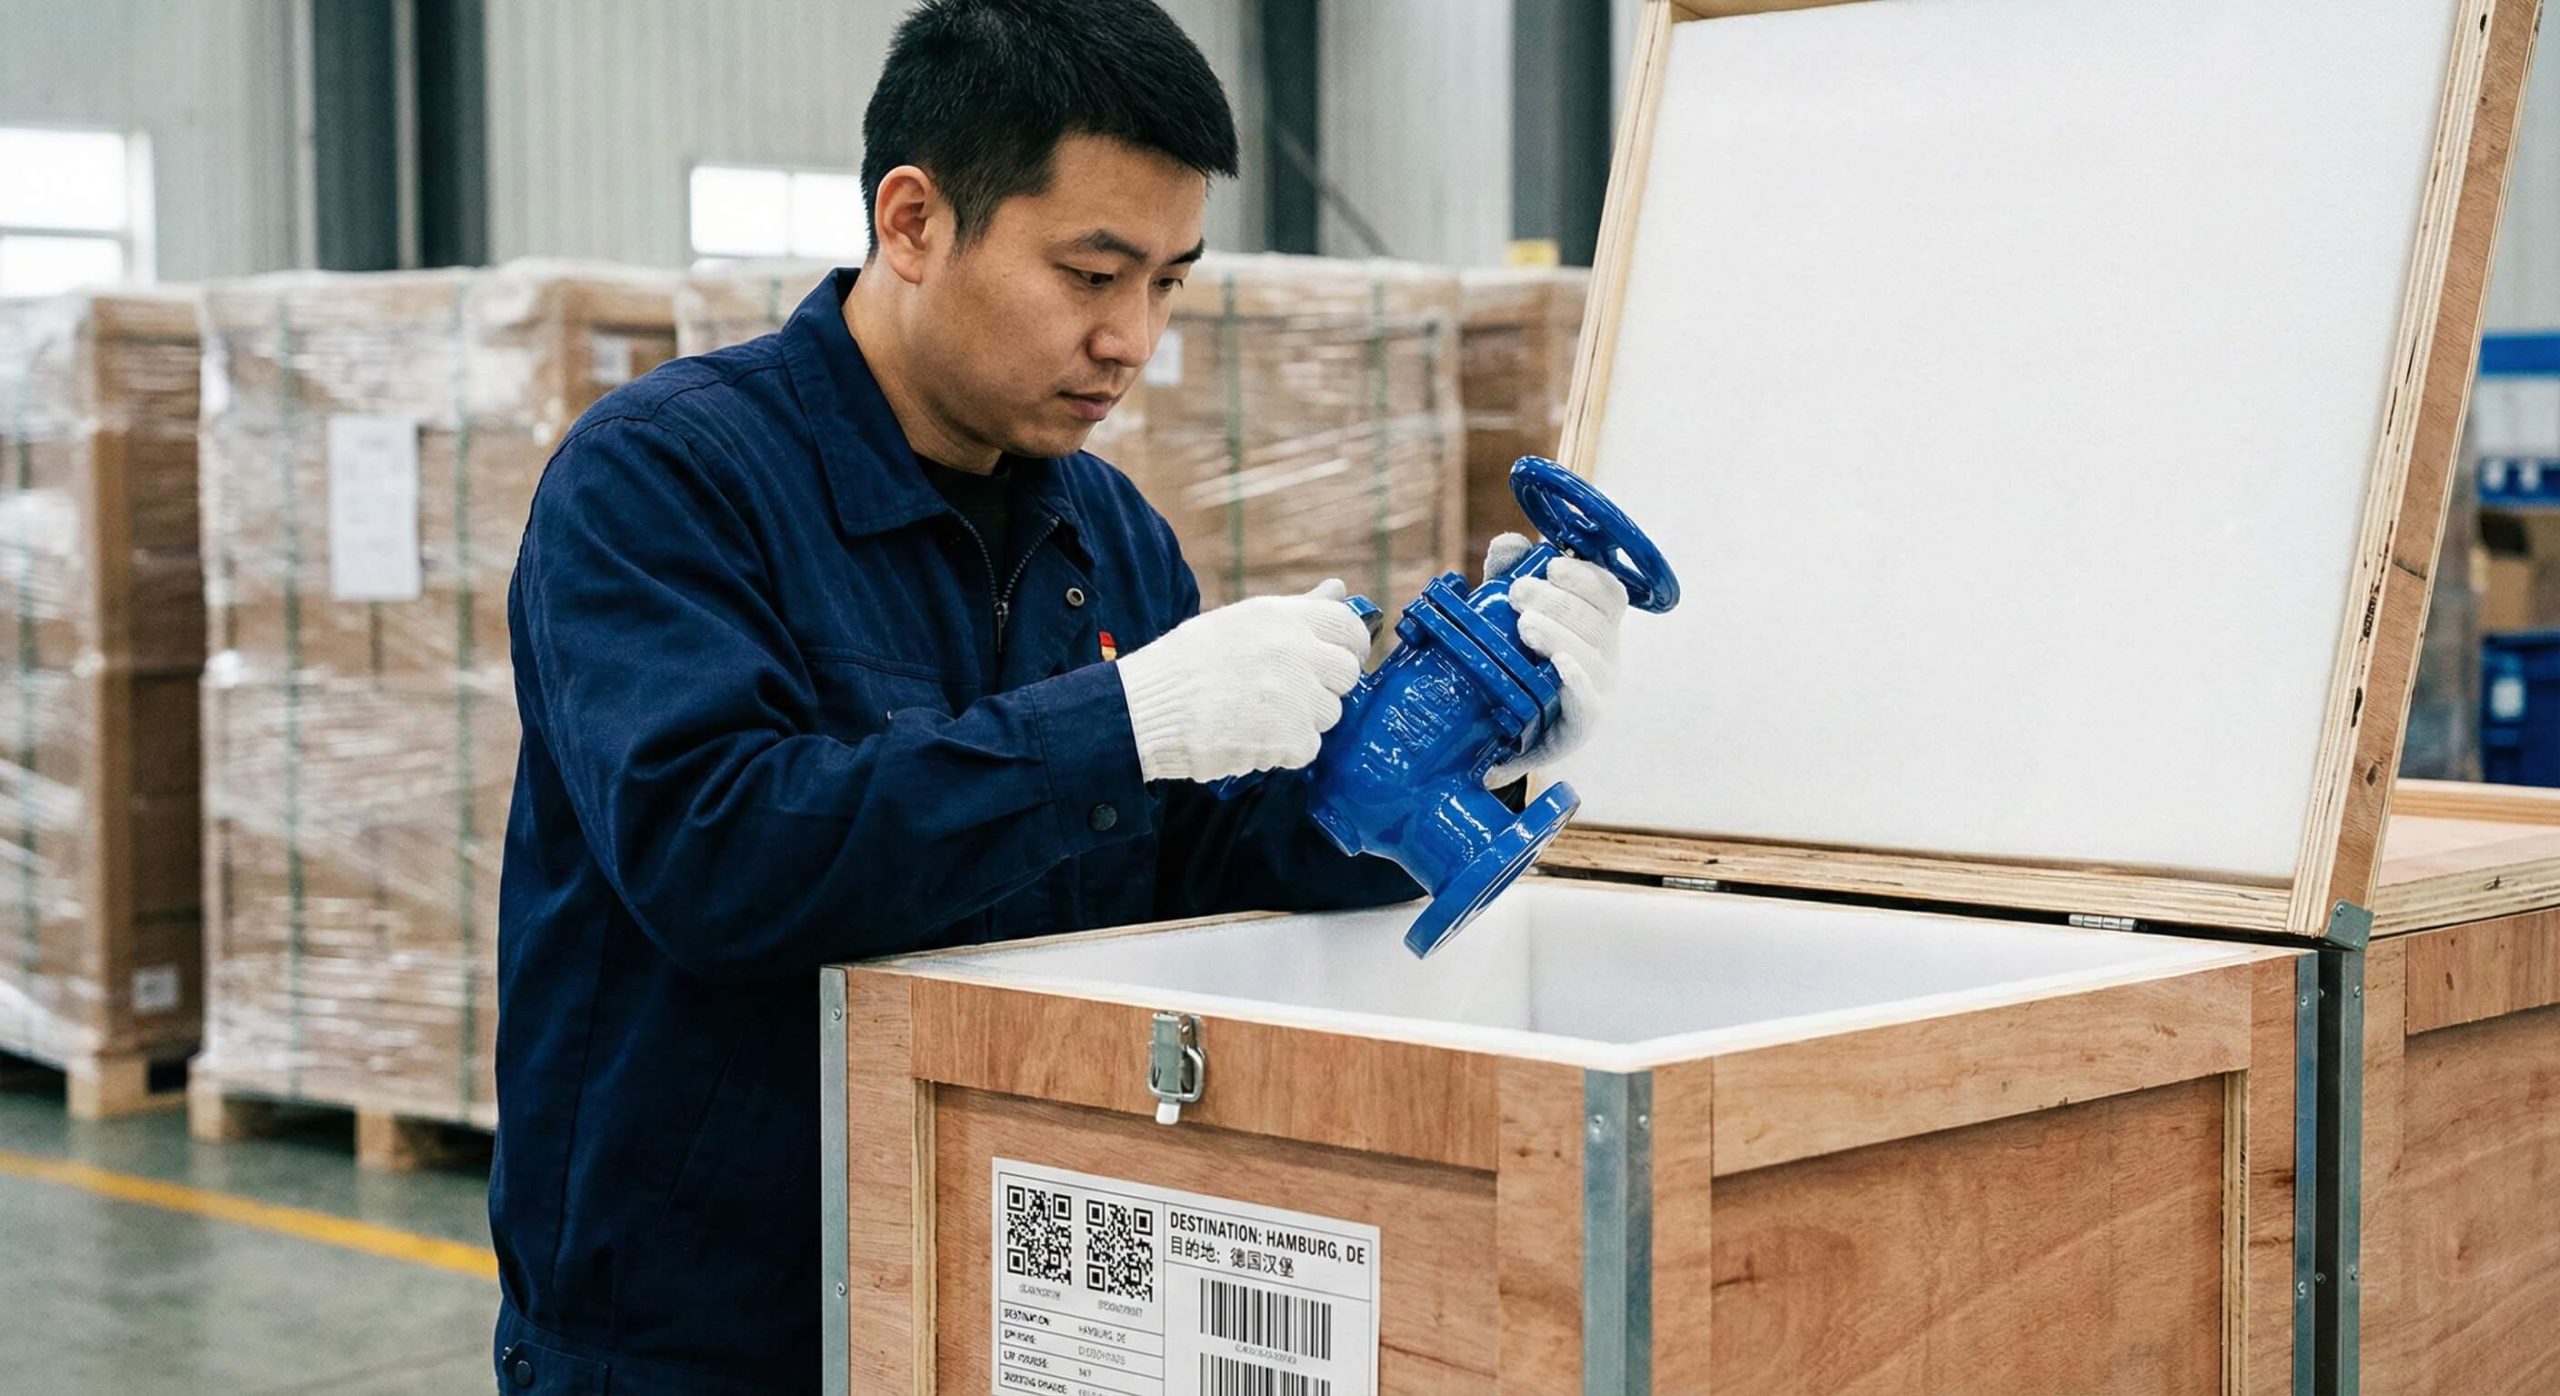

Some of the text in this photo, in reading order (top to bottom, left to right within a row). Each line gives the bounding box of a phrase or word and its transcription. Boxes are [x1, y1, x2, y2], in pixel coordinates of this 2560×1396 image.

[1170, 1211, 1365, 1265] DESTINATION: HAMBURG, DE
